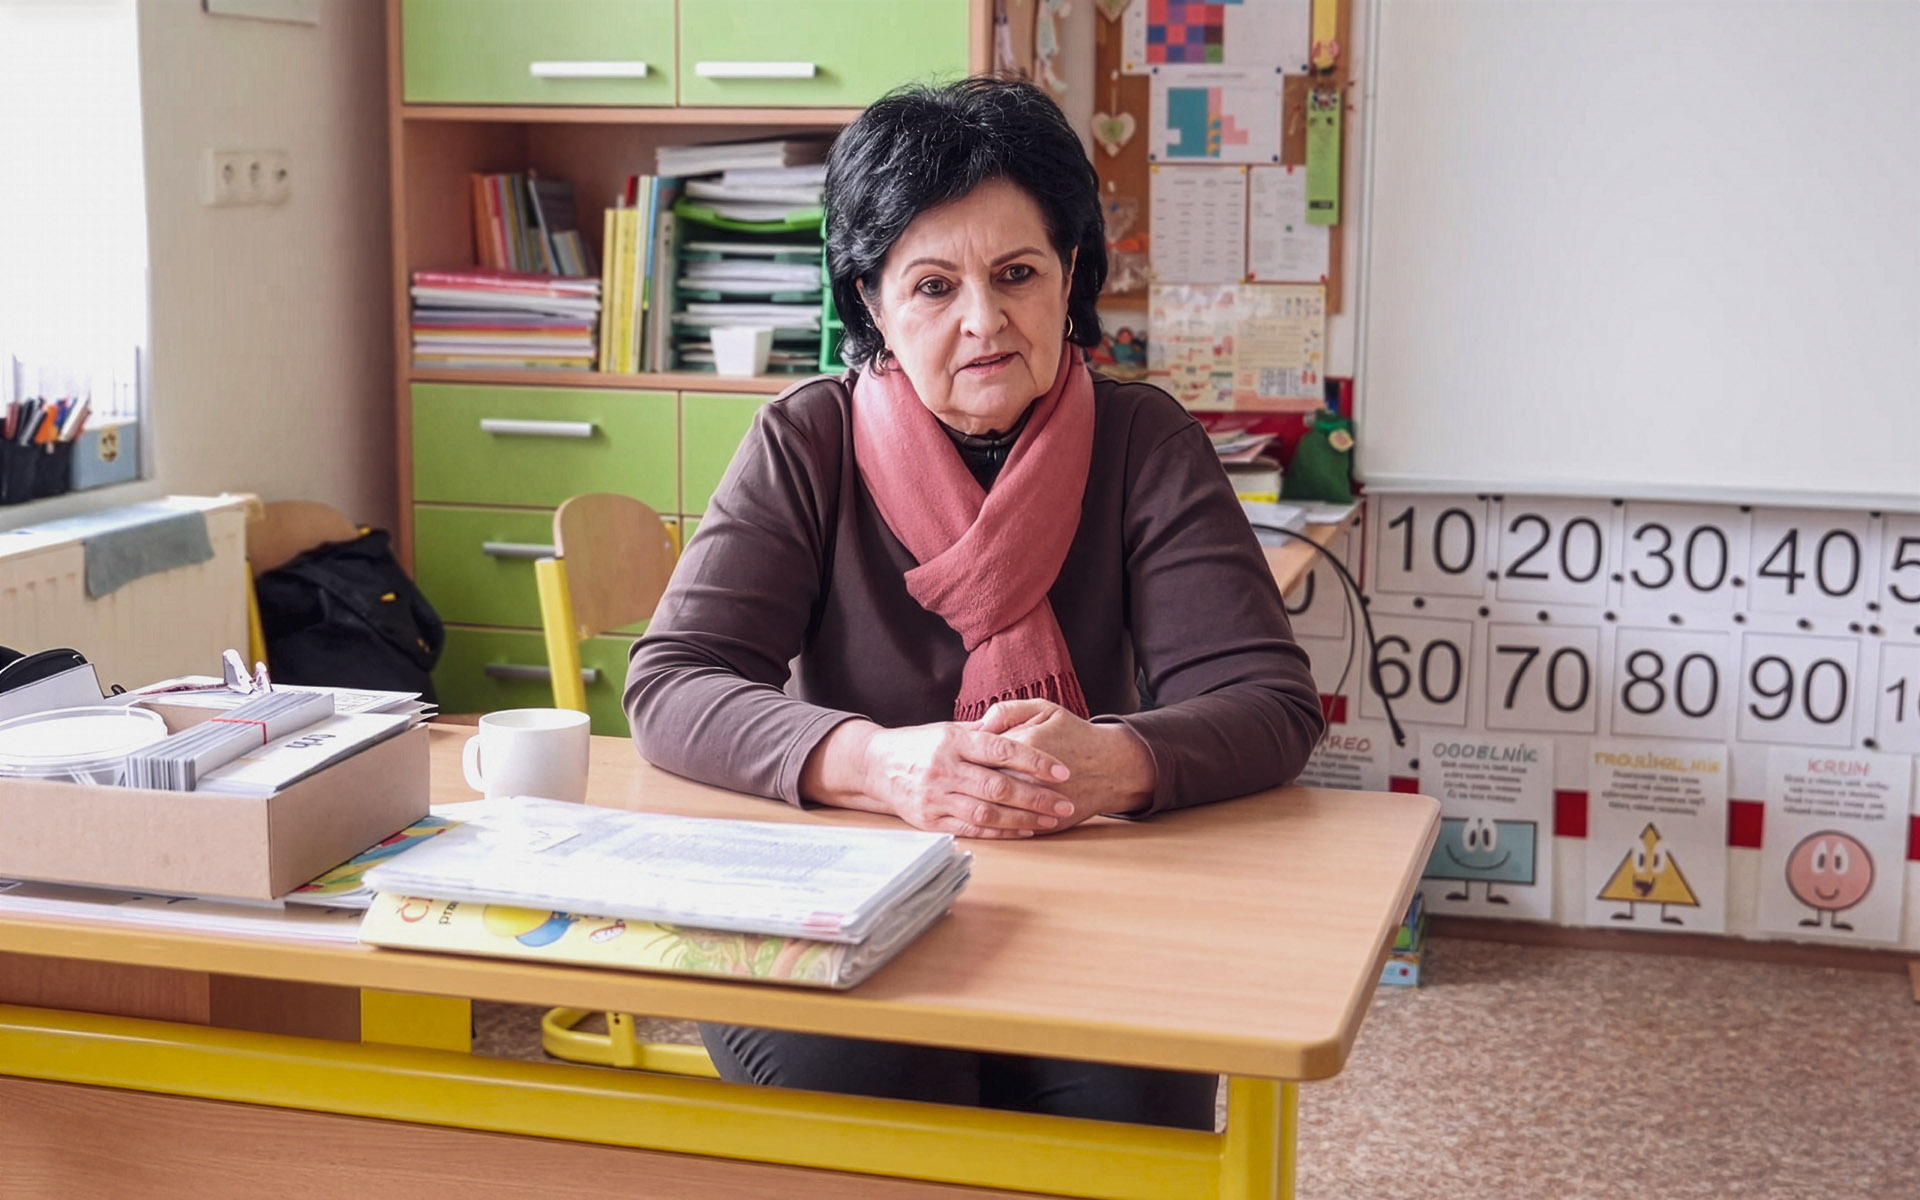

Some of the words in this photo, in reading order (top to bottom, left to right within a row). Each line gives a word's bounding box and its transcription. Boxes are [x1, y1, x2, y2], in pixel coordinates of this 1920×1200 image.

[1388, 506, 1475, 575] 10
[1505, 514, 1602, 582] 20
[1631, 523, 1727, 591] 30
[1758, 529, 1860, 596] 40
[1889, 537, 1920, 603] 5
[1370, 635, 1461, 704] 60
[1496, 645, 1591, 713] 70
[1621, 650, 1718, 718] 80
[1749, 656, 1848, 724] 90
[1886, 678, 1920, 722] 1
